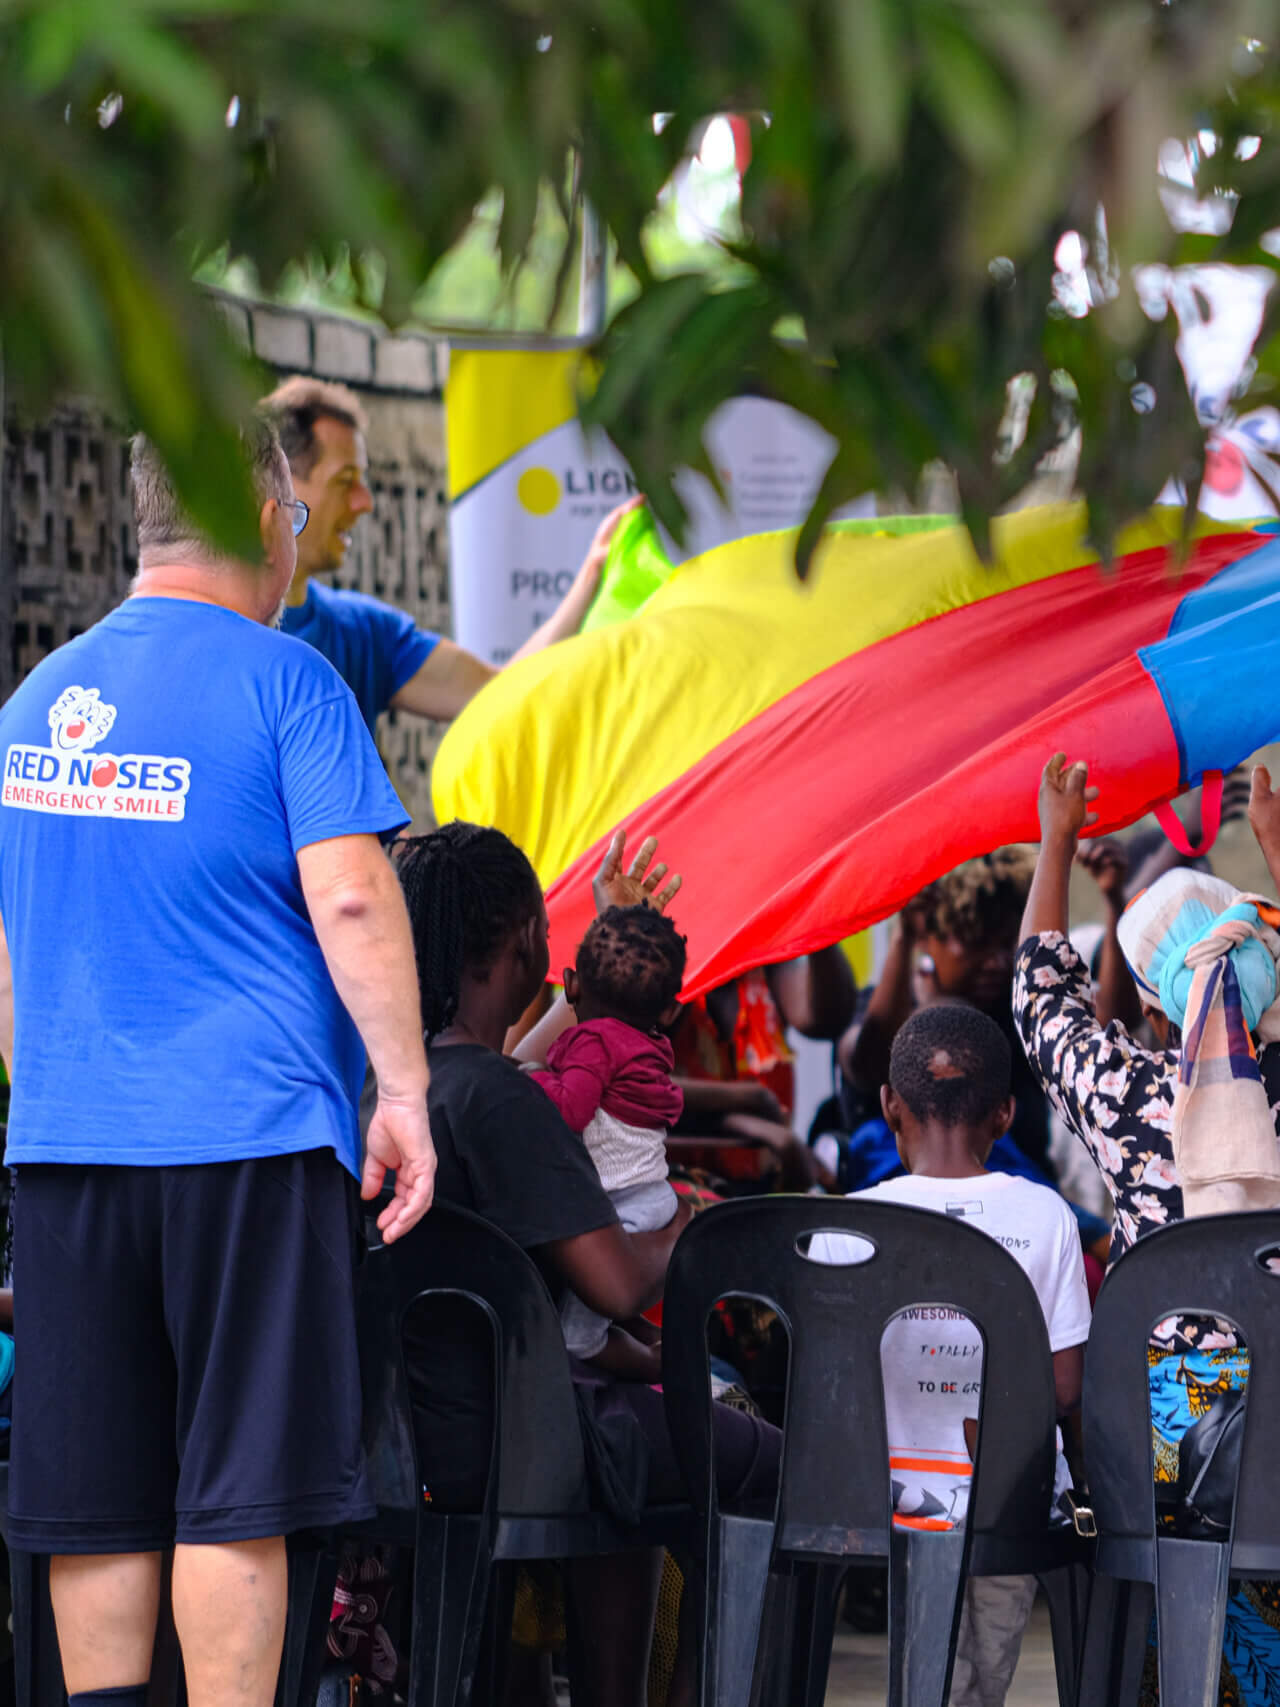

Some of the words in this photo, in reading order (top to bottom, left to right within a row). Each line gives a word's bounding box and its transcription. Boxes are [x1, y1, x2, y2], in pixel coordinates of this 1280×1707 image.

[7, 750, 60, 783] RED
[67, 758, 185, 793] NOSES
[5, 785, 107, 811] EMERGENCY
[113, 796, 180, 816] SMILE
[918, 1381, 936, 1393] TO
